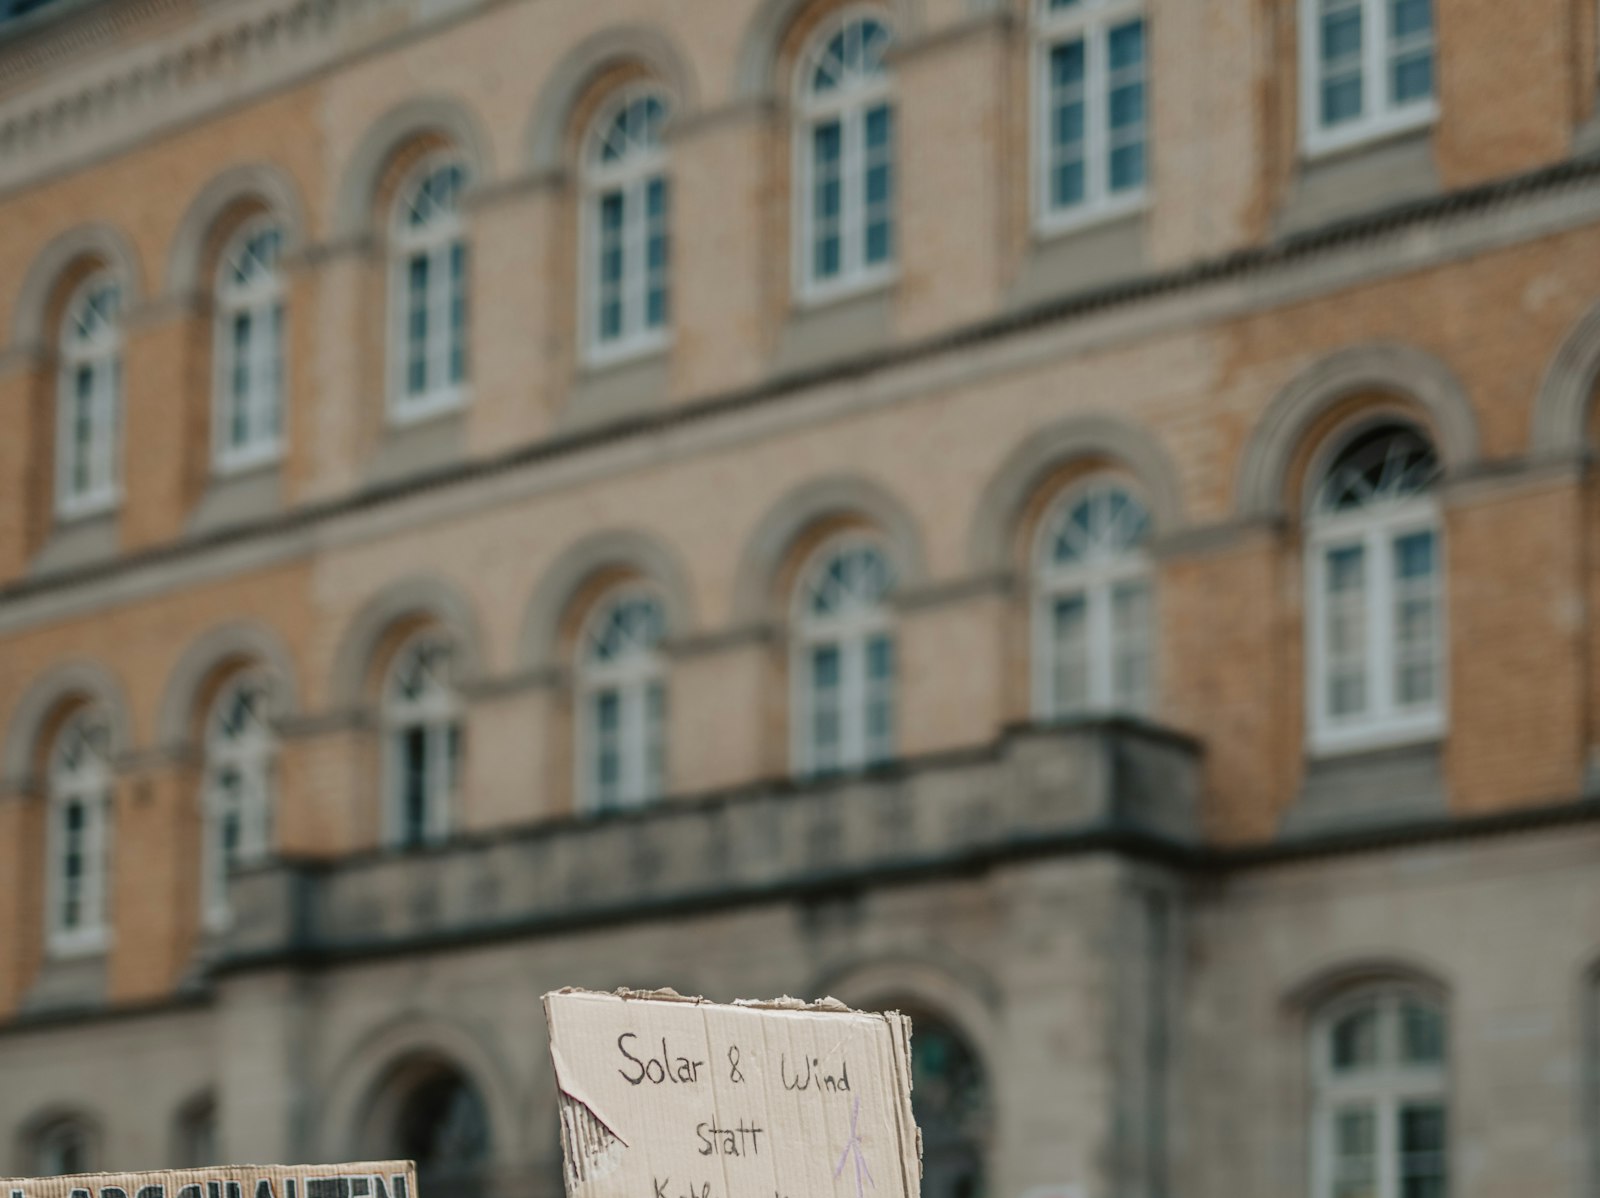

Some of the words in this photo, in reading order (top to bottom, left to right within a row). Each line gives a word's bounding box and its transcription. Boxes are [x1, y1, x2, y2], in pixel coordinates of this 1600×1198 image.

[617, 1032, 703, 1085] Solar
[727, 1045, 745, 1084] &
[781, 1053, 851, 1092] Wind
